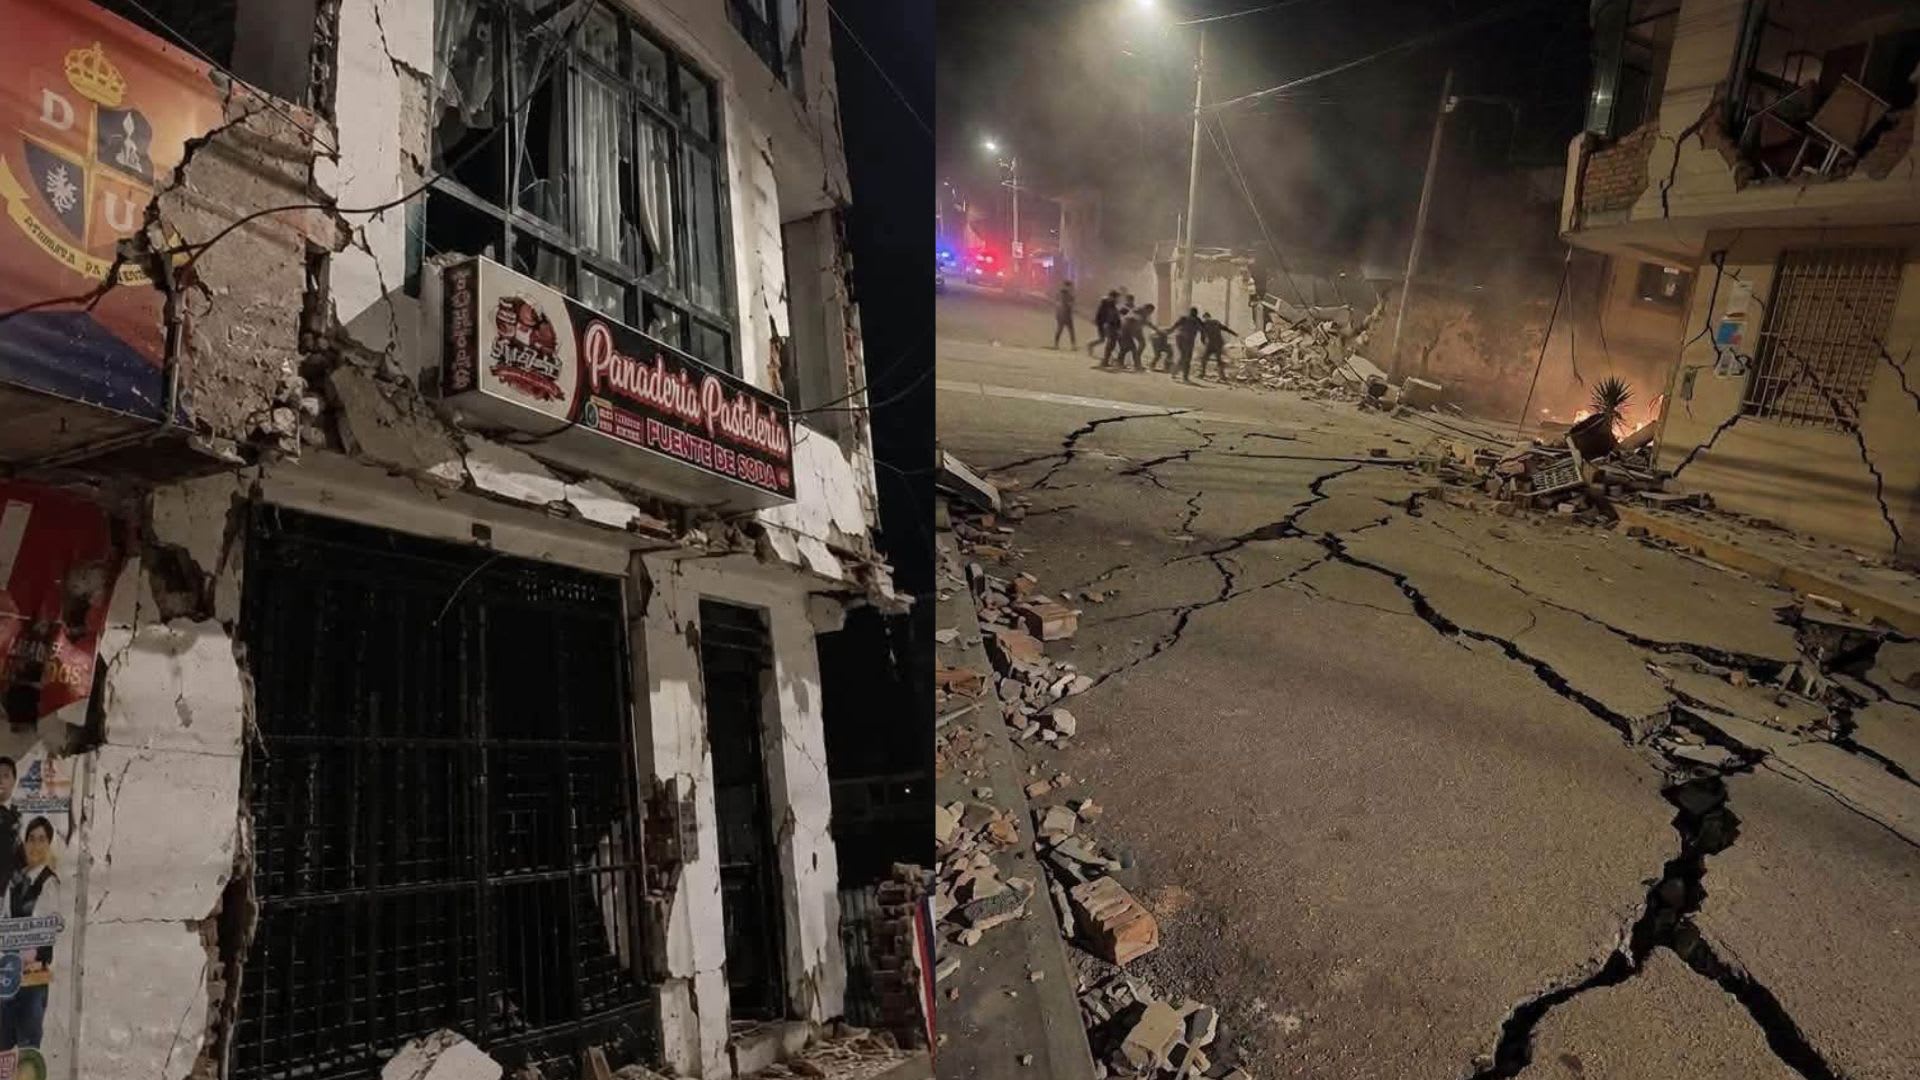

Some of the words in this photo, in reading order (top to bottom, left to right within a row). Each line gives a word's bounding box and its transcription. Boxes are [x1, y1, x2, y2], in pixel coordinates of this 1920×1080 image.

[40, 88, 75, 130] D
[105, 192, 138, 232] U
[584, 322, 700, 420] Panaderia
[702, 374, 789, 456] Pasteleria
[646, 417, 713, 468] FUENTE
[714, 444, 737, 476] DE
